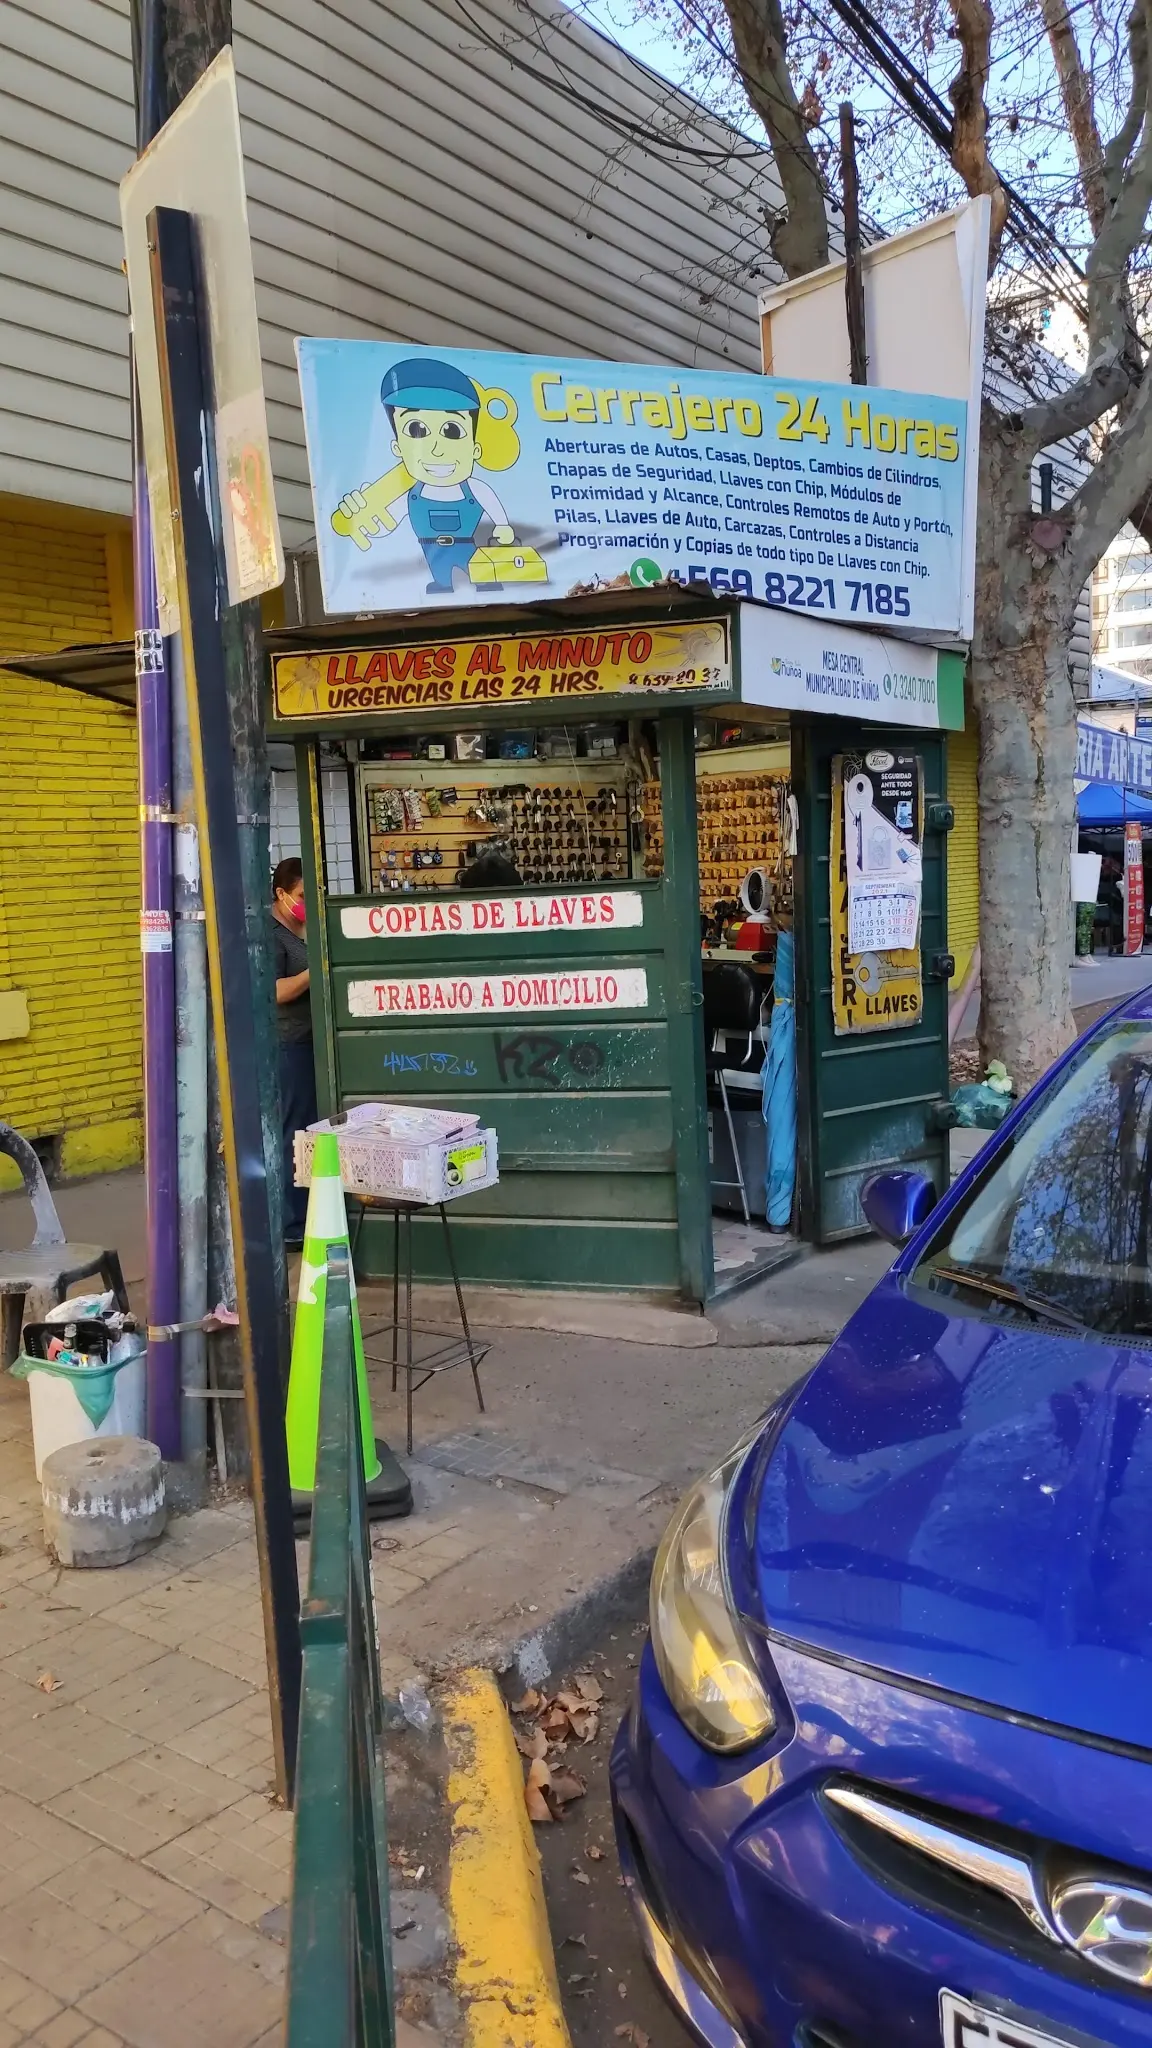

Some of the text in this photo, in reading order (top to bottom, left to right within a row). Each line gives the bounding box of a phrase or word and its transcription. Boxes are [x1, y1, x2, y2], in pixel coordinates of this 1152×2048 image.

[530, 371, 959, 462] Cerrajero 24 Horas
[544, 438, 942, 490] Aberturas de Autos, Casas, Deptos, Cambios de Cilindros,
[547, 462, 902, 506] Chapas de Seguridad, Llaves con Chip, Módulos de
[551, 485, 954, 538] Proximidad y Alcance, Controles Remotos de Auto y Portón,
[554, 508, 919, 554] Pilas, Llaves de Auto, Carcazas, Controles a Distancia
[558, 532, 931, 578] Programación y Copias de todo tipo De Llaves con Chip.
[764, 571, 837, 610] 8221
[844, 580, 911, 617] 7185
[327, 631, 653, 686] LLAVES AL MINUTO
[822, 650, 839, 671] MESA
[840, 654, 865, 676] CENTRAL
[328, 681, 454, 709] URGENCIAS
[460, 677, 504, 700] LAS
[510, 674, 541, 697] 24
[550, 669, 604, 693] HRS.
[806, 671, 936, 704] MUNICIPALIDAD DE ÑUÑOA 2 3240 7000
[881, 772, 912, 780] SEGURIDAD
[368, 895, 616, 934] COPIAS DE LLAVES
[876, 928, 885, 936] 23
[902, 926, 912, 934] 26
[877, 937, 886, 945] 30
[374, 975, 618, 1011] TRABAJO A DOMICILIO
[865, 994, 918, 1016] LLAVES
